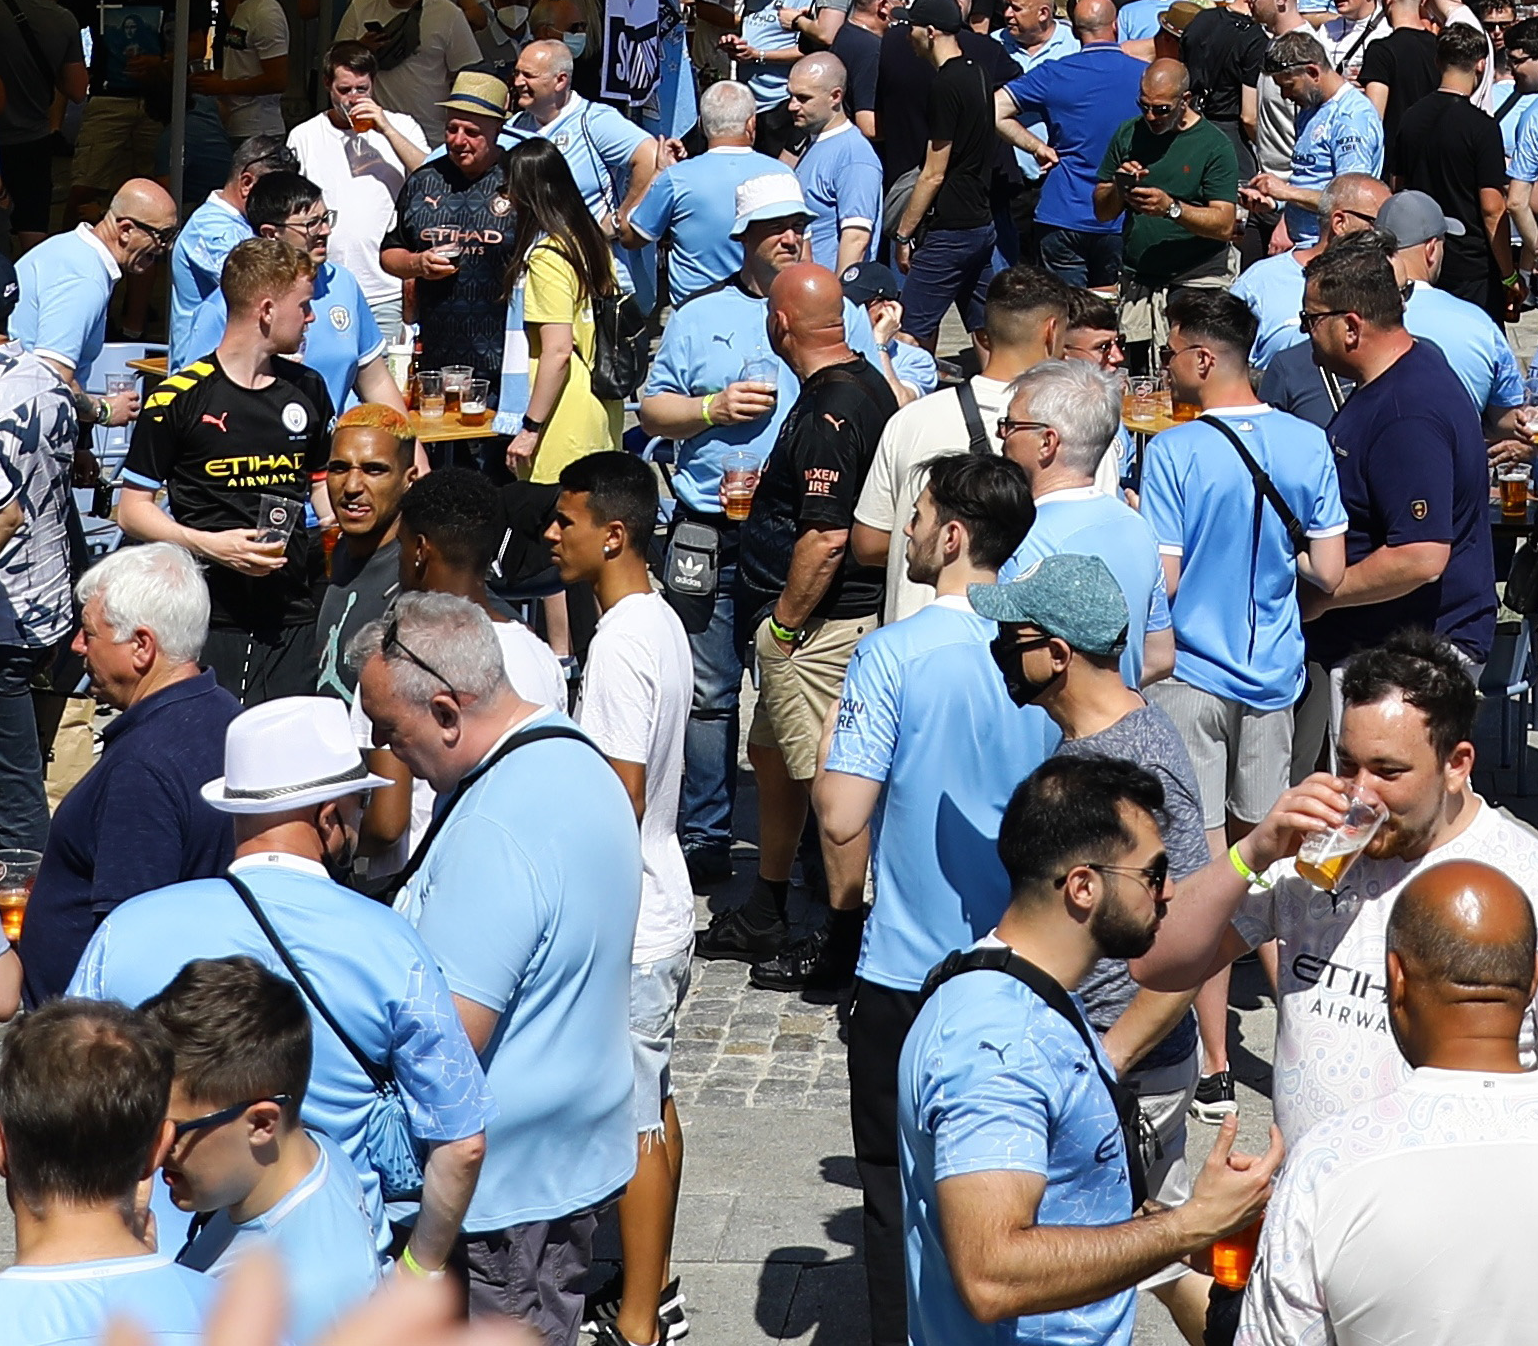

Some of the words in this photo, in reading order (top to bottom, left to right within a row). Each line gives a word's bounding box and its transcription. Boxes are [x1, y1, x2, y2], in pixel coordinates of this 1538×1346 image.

[420, 227, 503, 245] ETIHAD
[228, 473, 296, 487] AIRWAYS
[805, 467, 840, 483] NXEN
[808, 480, 832, 494] IRE
[675, 576, 702, 588] adidas
